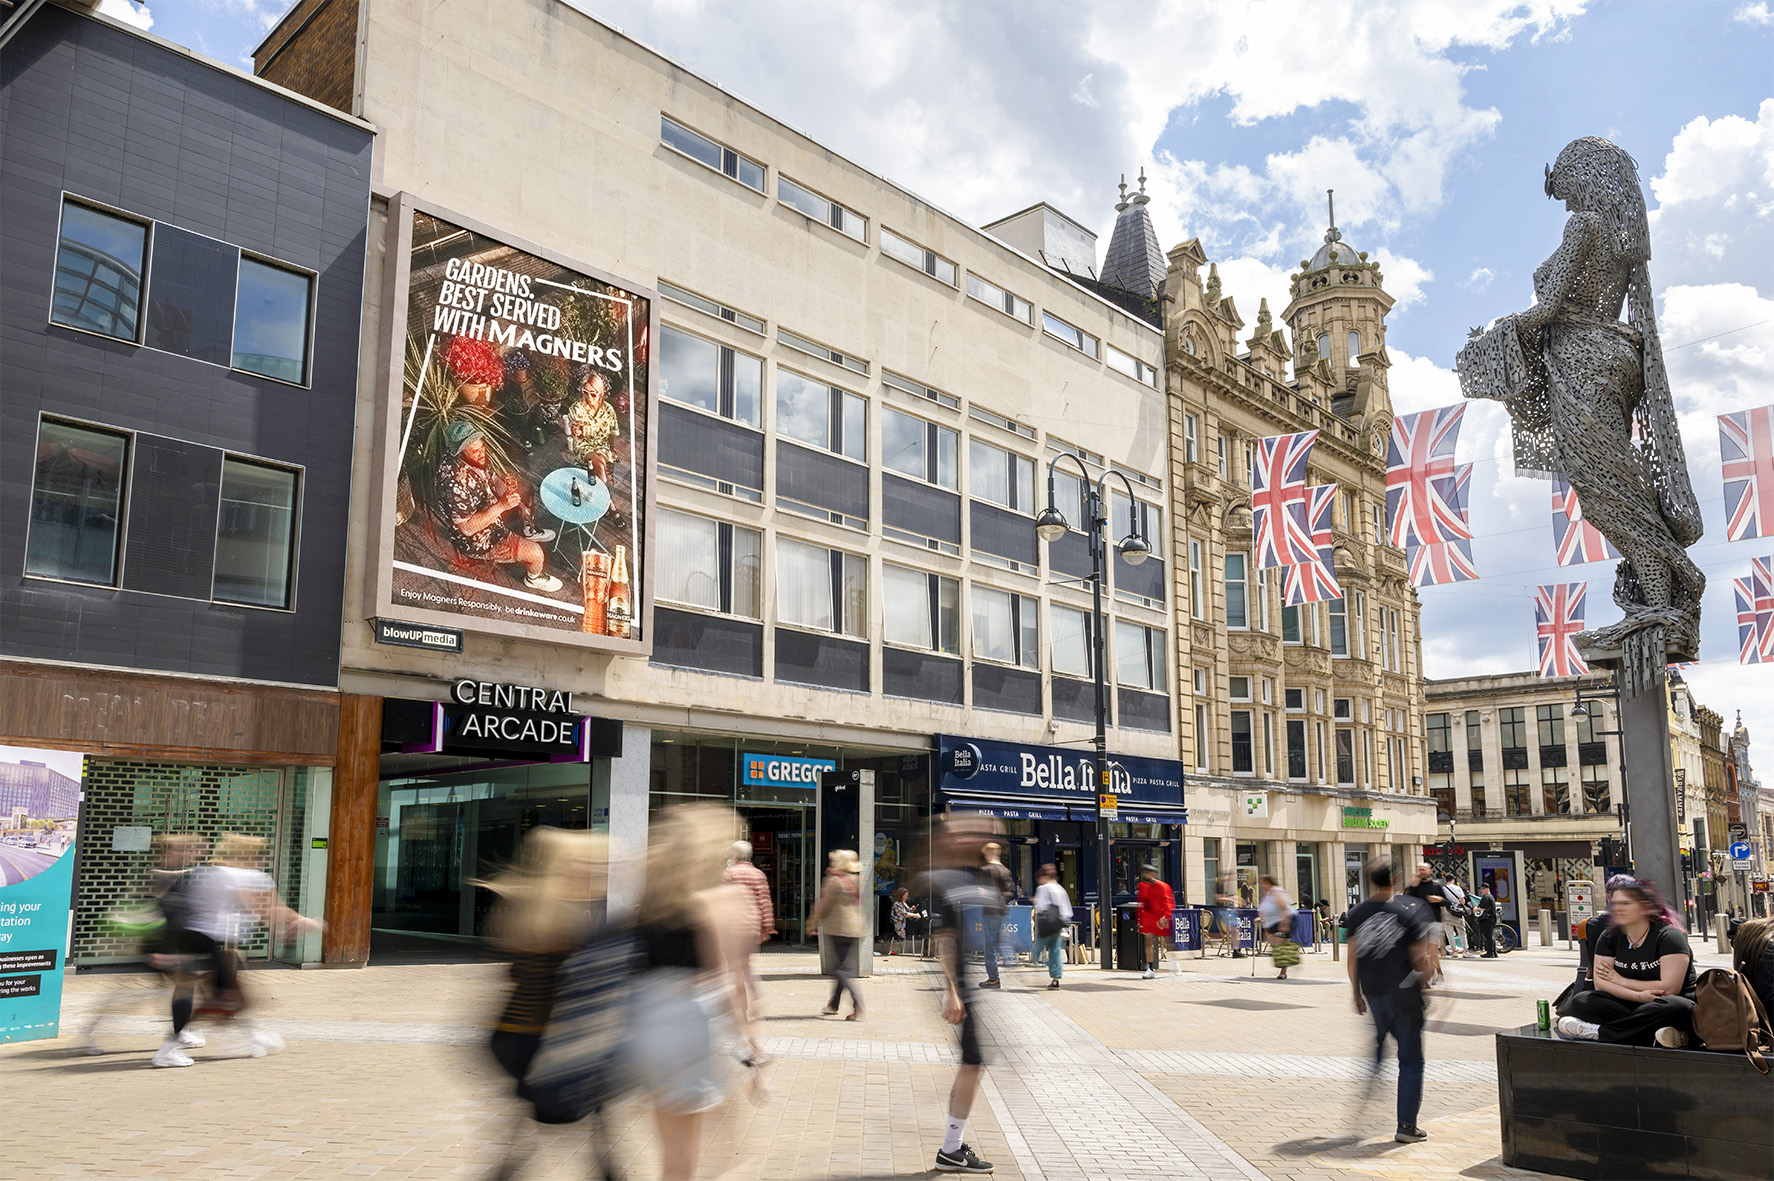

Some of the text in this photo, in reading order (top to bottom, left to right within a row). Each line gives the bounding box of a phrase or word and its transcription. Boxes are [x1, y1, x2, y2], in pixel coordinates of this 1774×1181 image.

[445, 257, 535, 299] GARDENS.
[438, 280, 561, 332] BEST SERVED
[433, 304, 623, 373] WITH MAGNERS
[400, 588, 422, 600] Enjoy
[422, 592, 458, 604] Magners
[455, 679, 580, 715] CENTRAL
[462, 714, 573, 745] ARCADE
[954, 750, 971, 759] Bella
[954, 758, 972, 767] Italia
[980, 752, 1180, 795] ASTA GRILL Bella Itlia PIZZA PASTA GRILL
[1028, 811, 1042, 819] GRILL
[1369, 818, 1391, 829] SOCIETY
[0, 902, 42, 914] ing your
[0, 916, 31, 927] tation
[1175, 917, 1191, 930] Bella
[1236, 917, 1251, 929] Bella
[0, 933, 13, 943] ay
[1174, 930, 1191, 943] Italia
[16, 961, 51, 969] improvements
[1631, 962, 1638, 970] &
